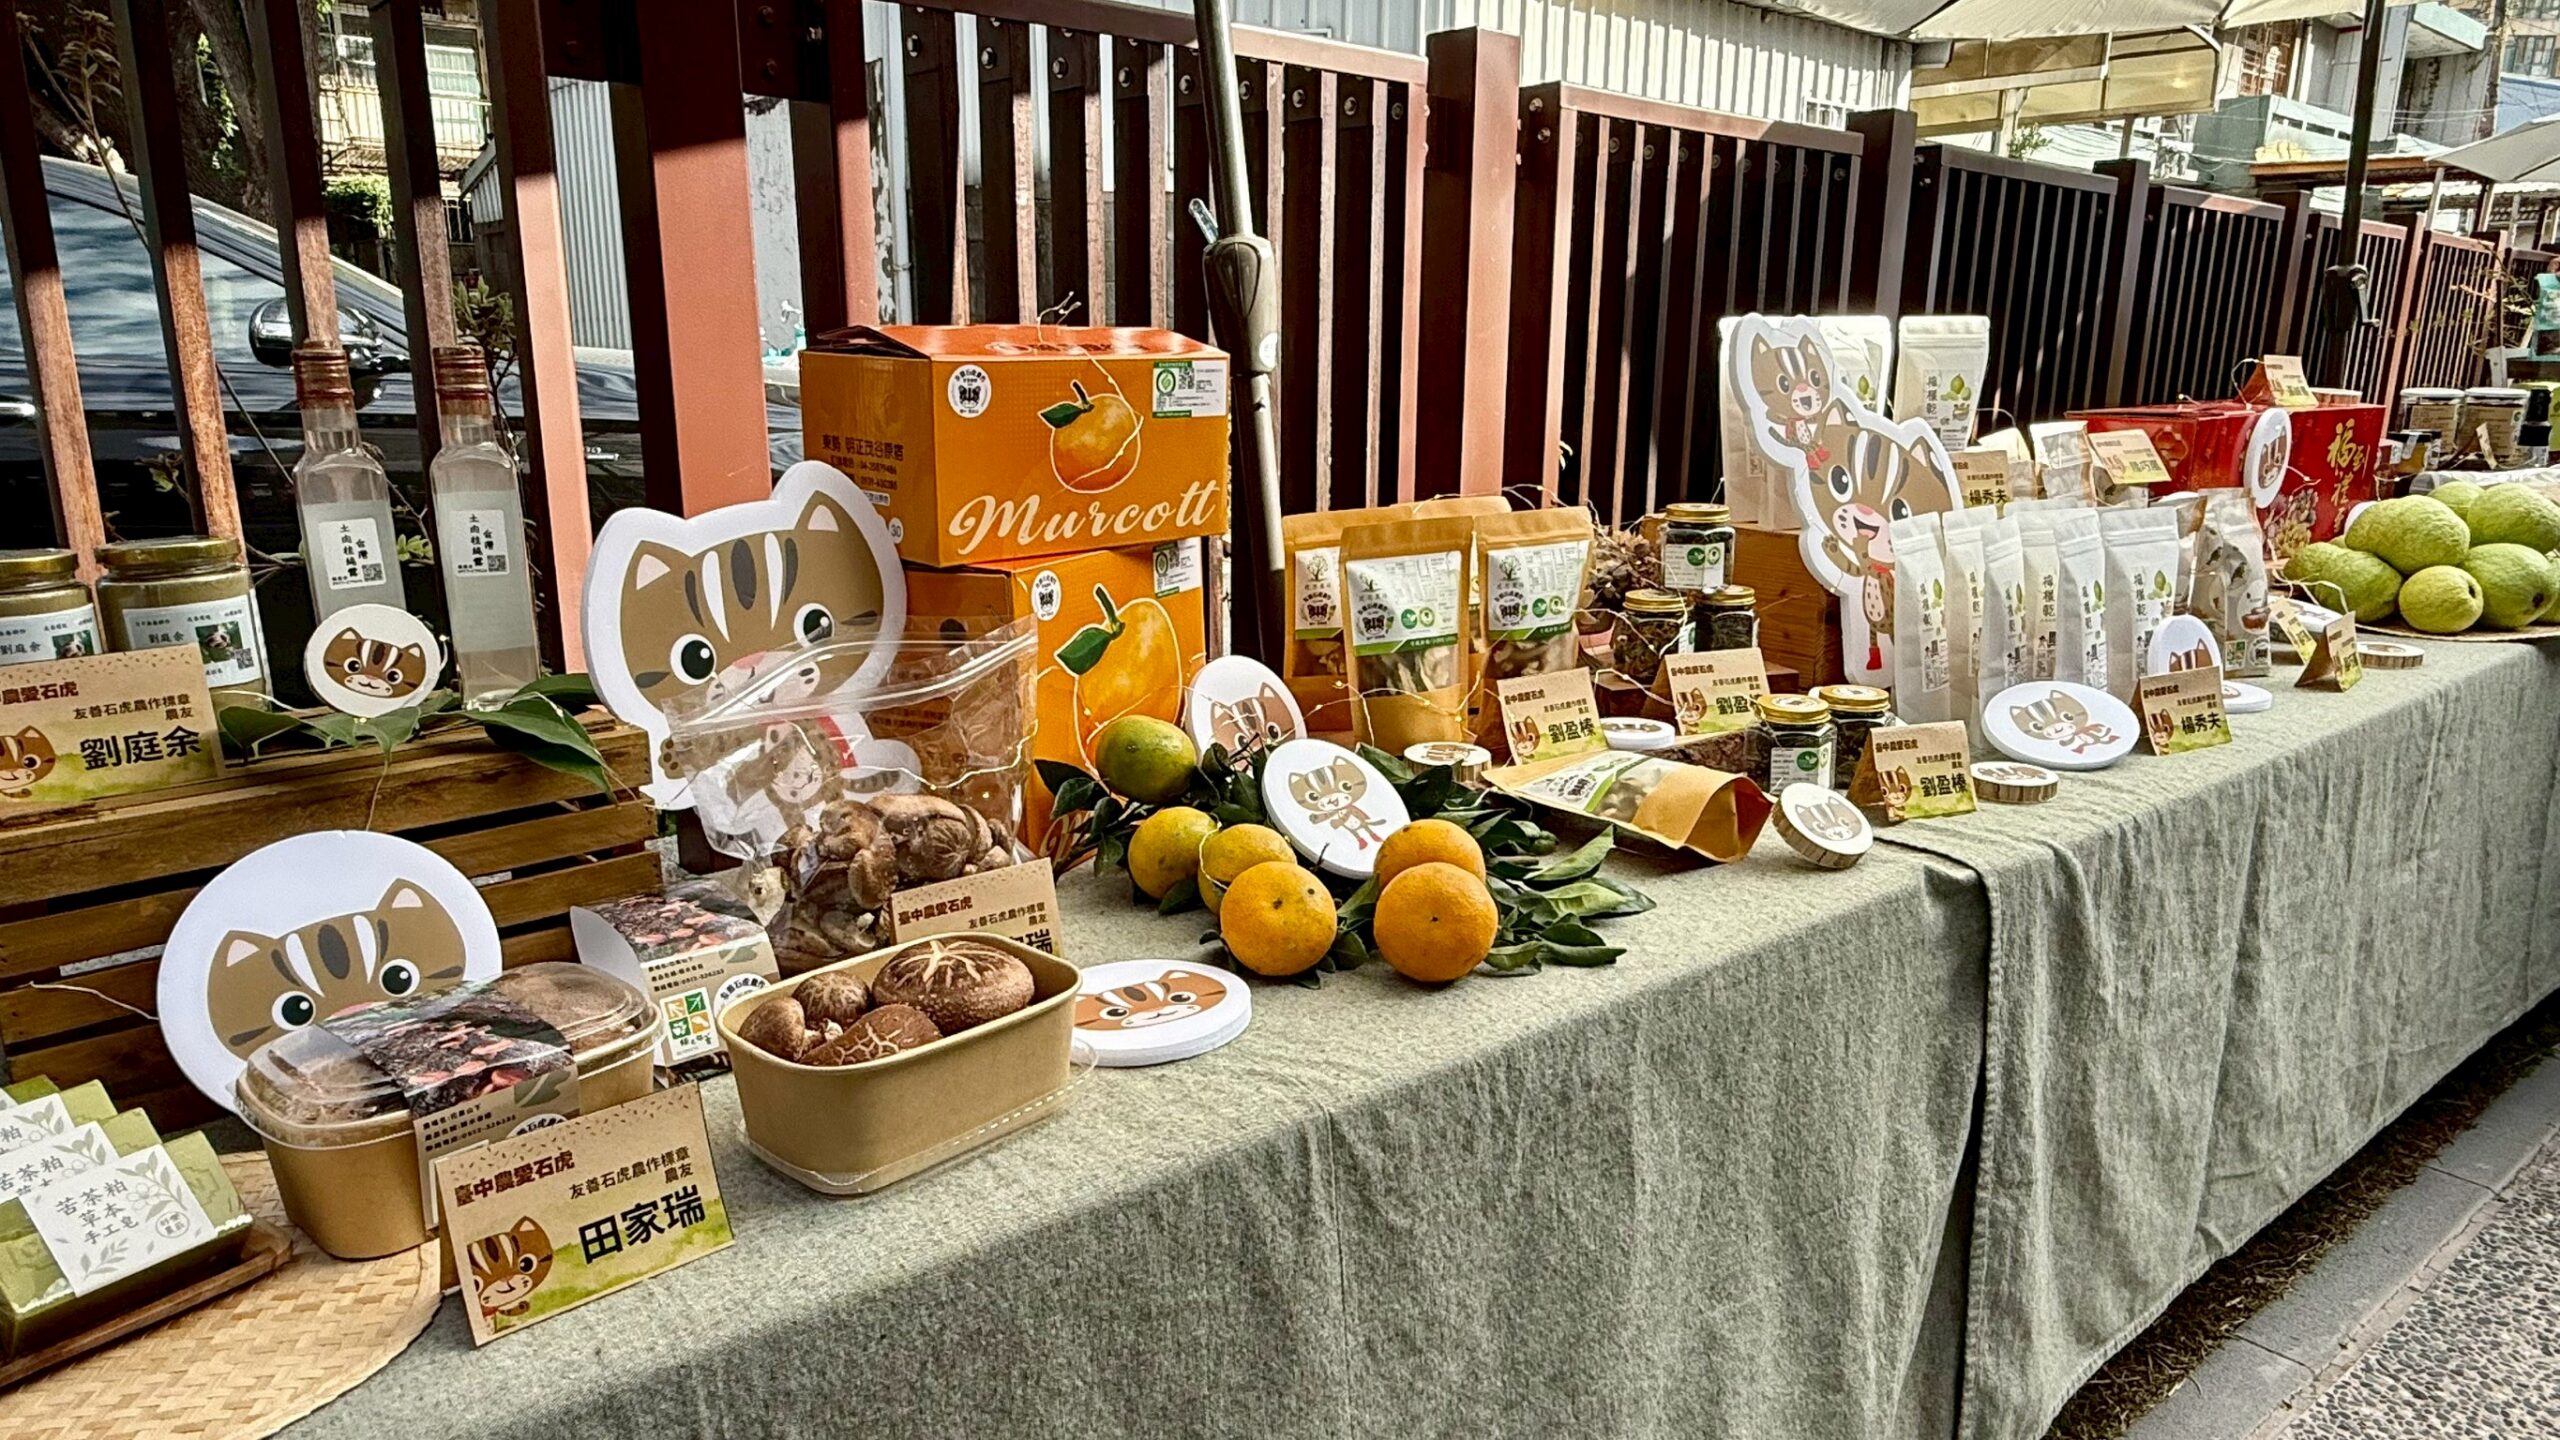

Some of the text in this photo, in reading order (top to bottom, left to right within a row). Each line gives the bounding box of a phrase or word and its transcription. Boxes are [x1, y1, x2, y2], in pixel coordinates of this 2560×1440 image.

[1969, 488, 2008, 506] 楊秀夫
[948, 479, 1221, 556] Murcott
[73, 693, 191, 719] 友善石虎農作標章
[165, 707, 194, 721] 農友
[1548, 717, 1597, 744] 劉盈榛
[2181, 711, 2222, 735] 楊秀夫
[80, 725, 202, 771] 劉庭余
[1920, 773, 1968, 798] 劉盈榛
[898, 896, 973, 926] 臺中農愛石虎
[968, 902, 1046, 929] 友善石虎農作標章
[1028, 913, 1048, 926] 農友
[0, 1155, 64, 1192] 苦茶粕
[454, 1151, 576, 1208] 臺中農愛石虎
[569, 1146, 691, 1200] 友善石虎農作標章
[664, 1163, 694, 1184] 農友
[55, 1179, 128, 1218] 苦茶粕
[78, 1203, 126, 1229] 草本
[578, 1184, 707, 1266] 田家瑞
[84, 1216, 139, 1245] 手工皂
